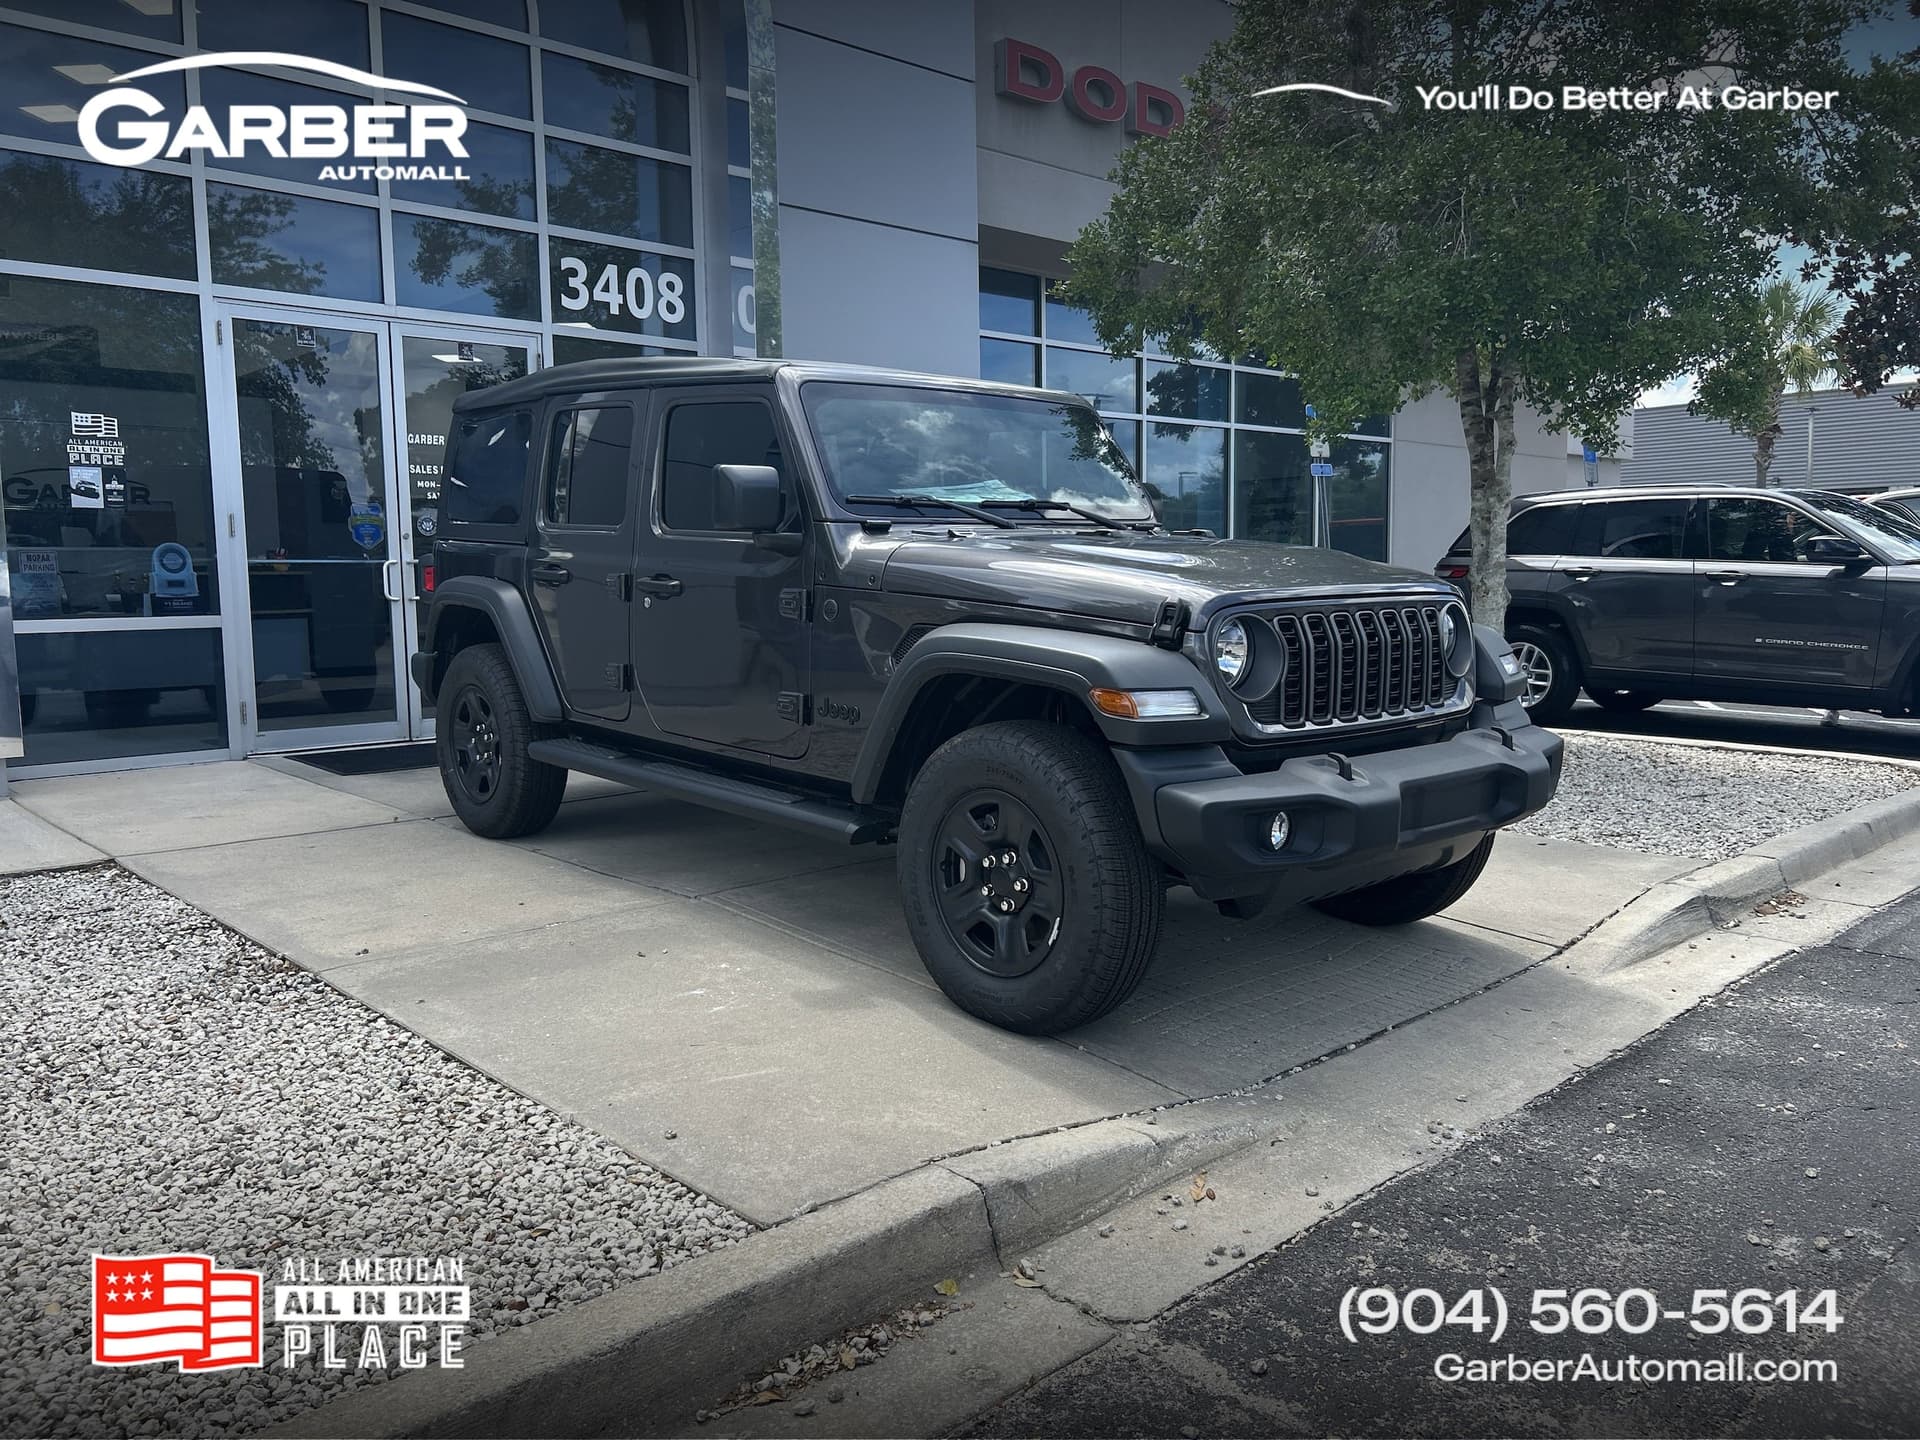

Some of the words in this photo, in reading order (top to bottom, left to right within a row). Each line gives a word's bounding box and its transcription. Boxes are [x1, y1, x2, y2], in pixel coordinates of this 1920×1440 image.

[995, 37, 1185, 139] DOD
[560, 257, 686, 325] 3408
[407, 433, 446, 446] GARBER
[70, 453, 124, 466] PLACE
[409, 464, 439, 475] SALES
[417, 480, 441, 488] MON-
[818, 696, 861, 725] Jeep
